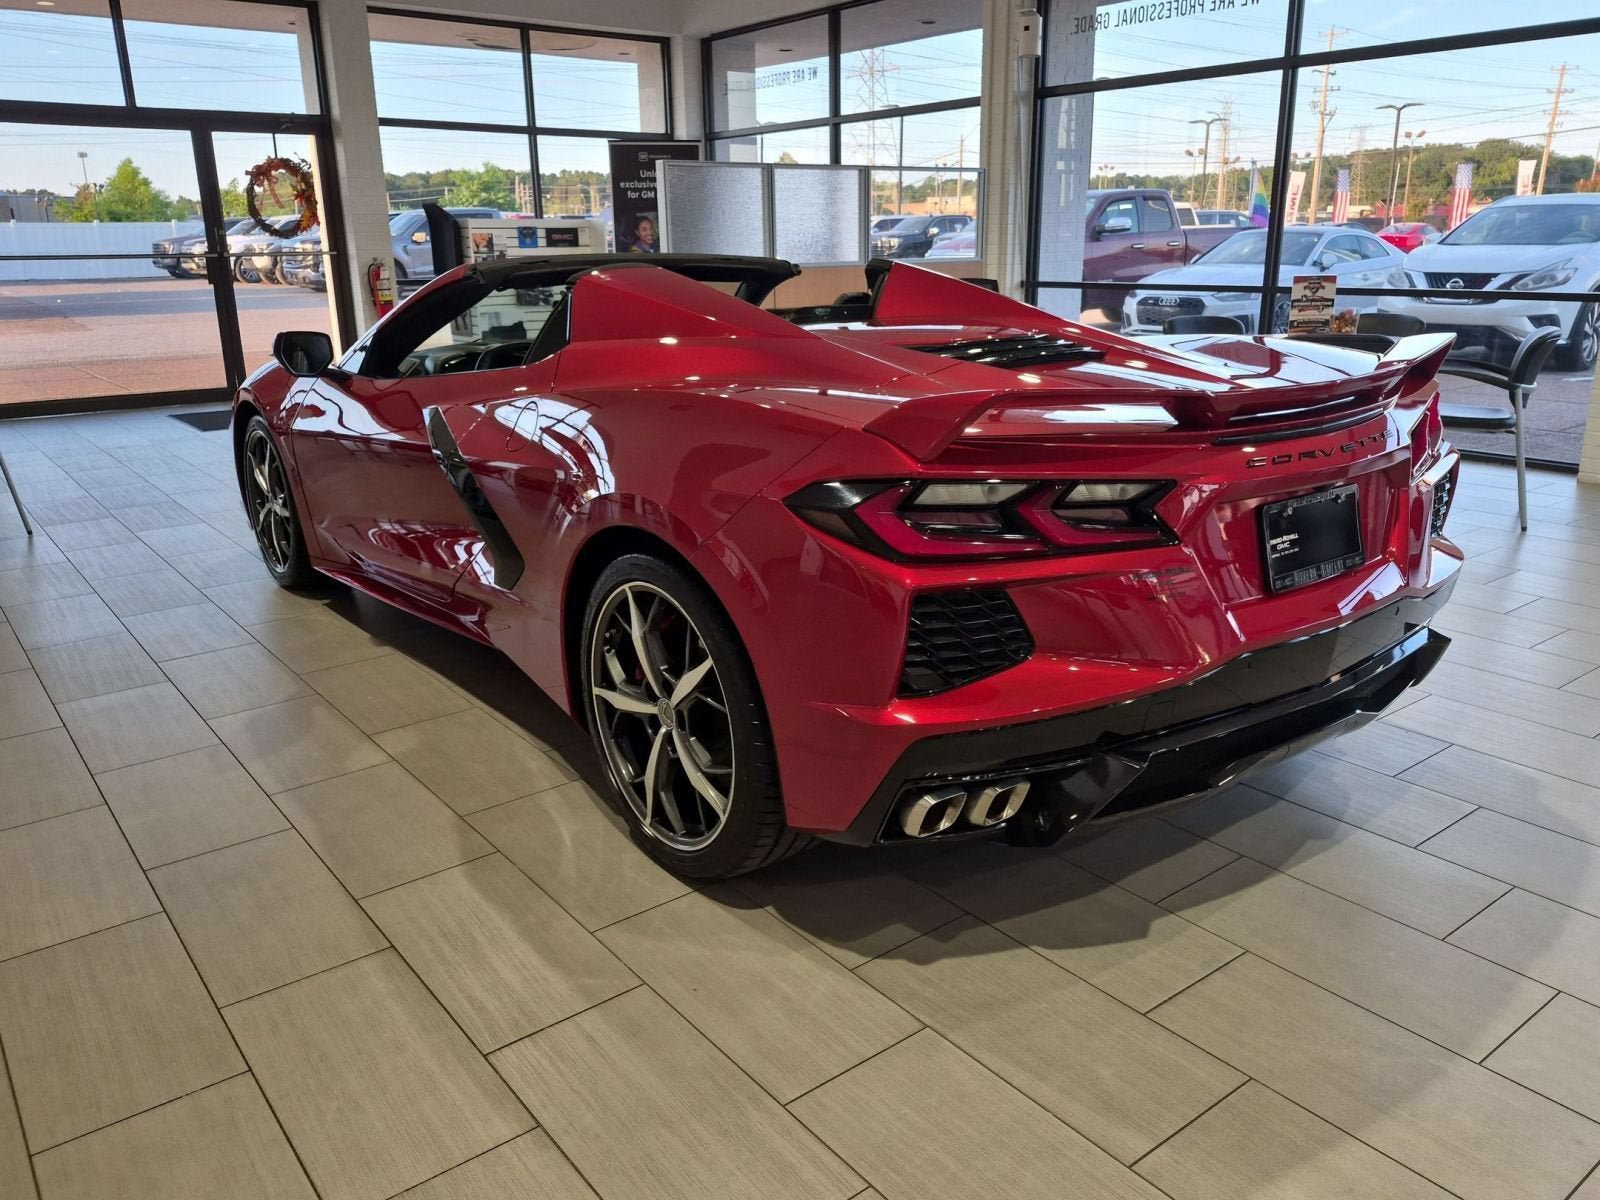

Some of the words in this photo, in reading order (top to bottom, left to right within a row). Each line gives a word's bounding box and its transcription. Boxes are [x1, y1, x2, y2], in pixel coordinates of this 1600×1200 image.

[627, 190, 640, 199] for
[641, 190, 655, 199] GM
[1246, 430, 1393, 468] CORVETTE
[1276, 541, 1291, 550] GMC
